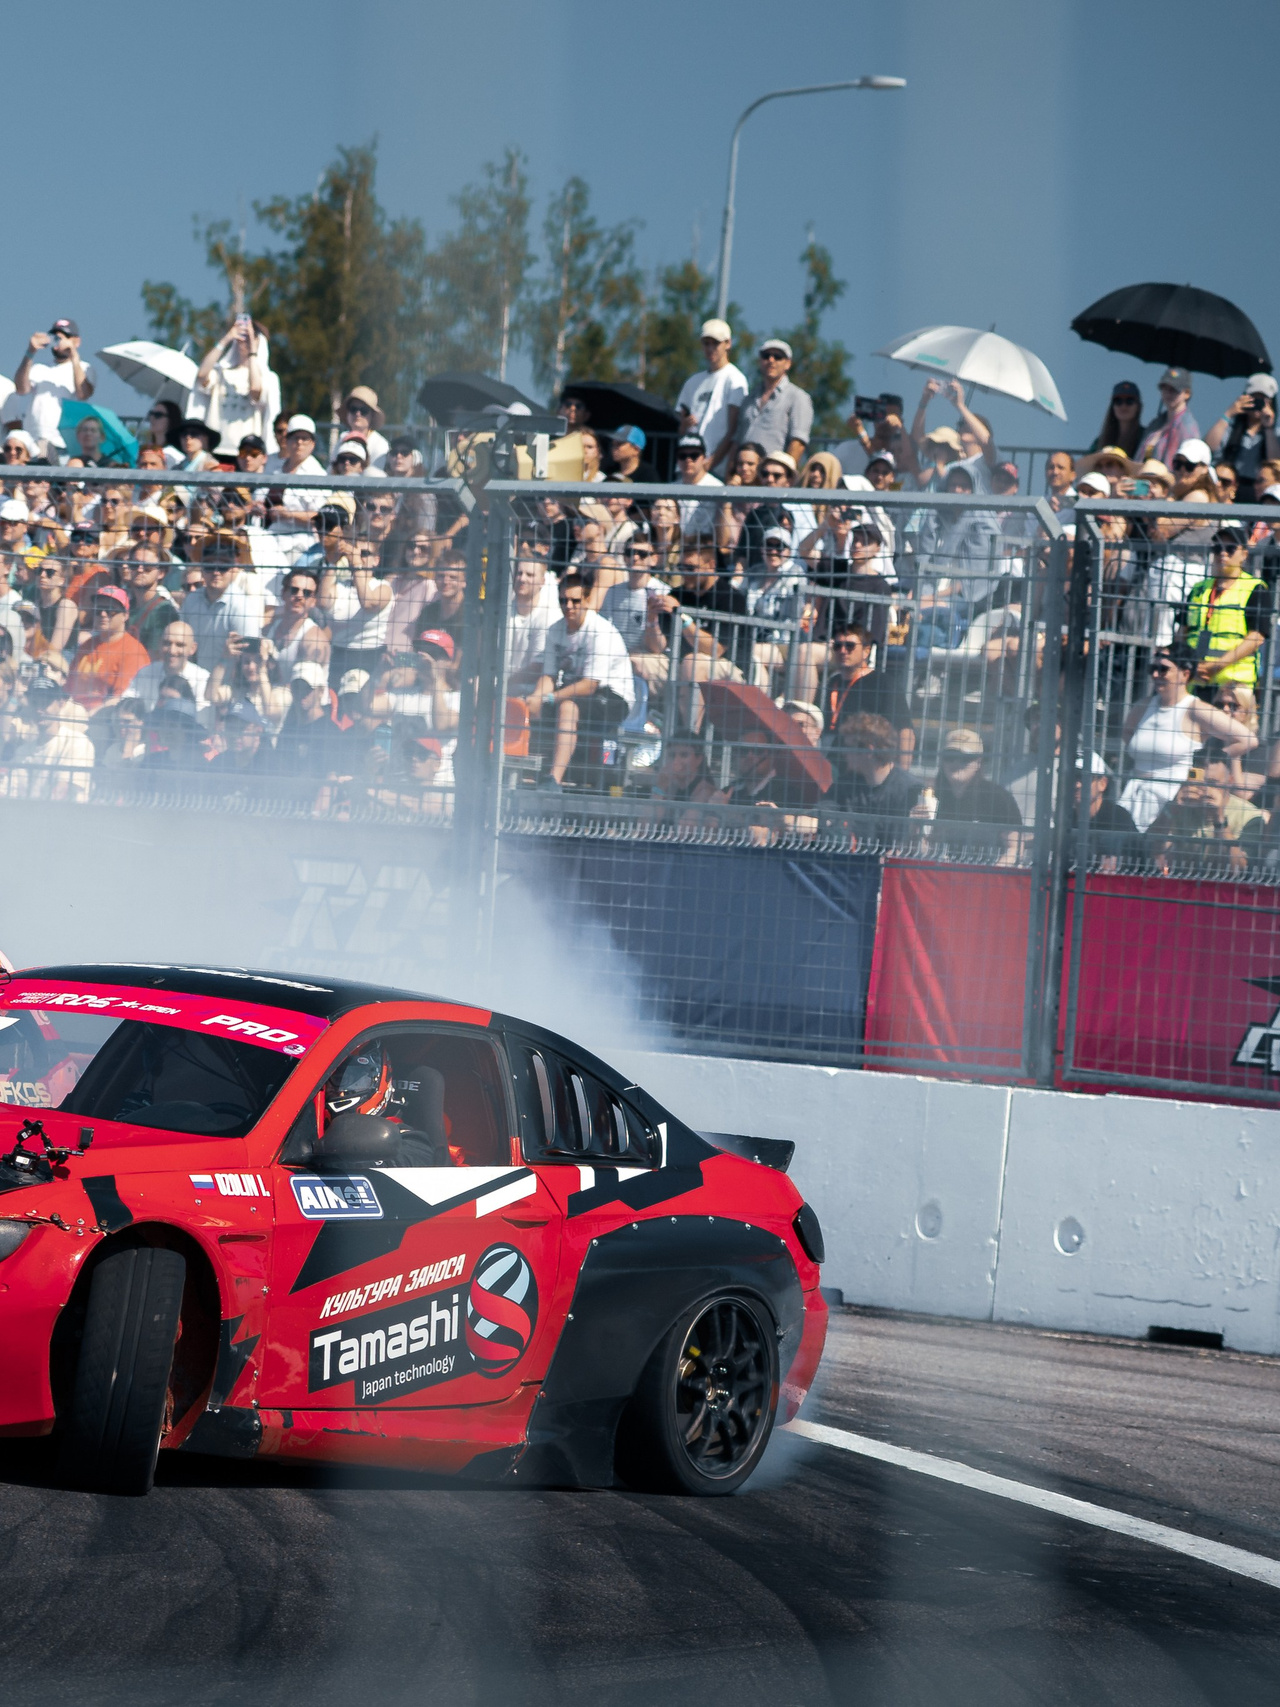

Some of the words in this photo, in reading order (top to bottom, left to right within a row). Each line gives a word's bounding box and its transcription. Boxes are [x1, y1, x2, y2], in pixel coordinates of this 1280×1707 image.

[46, 993, 122, 1008] RDS
[139, 1004, 182, 1015] OPEN
[201, 1014, 299, 1043] PRO
[214, 1173, 259, 1197] OZOLIN
[319, 1273, 403, 1319] КУЛЬТУРА
[404, 1253, 466, 1293] ЗАНОСА
[313, 1294, 459, 1380] Tamashi
[361, 1375, 392, 1399] Japan
[394, 1353, 456, 1386] technology
